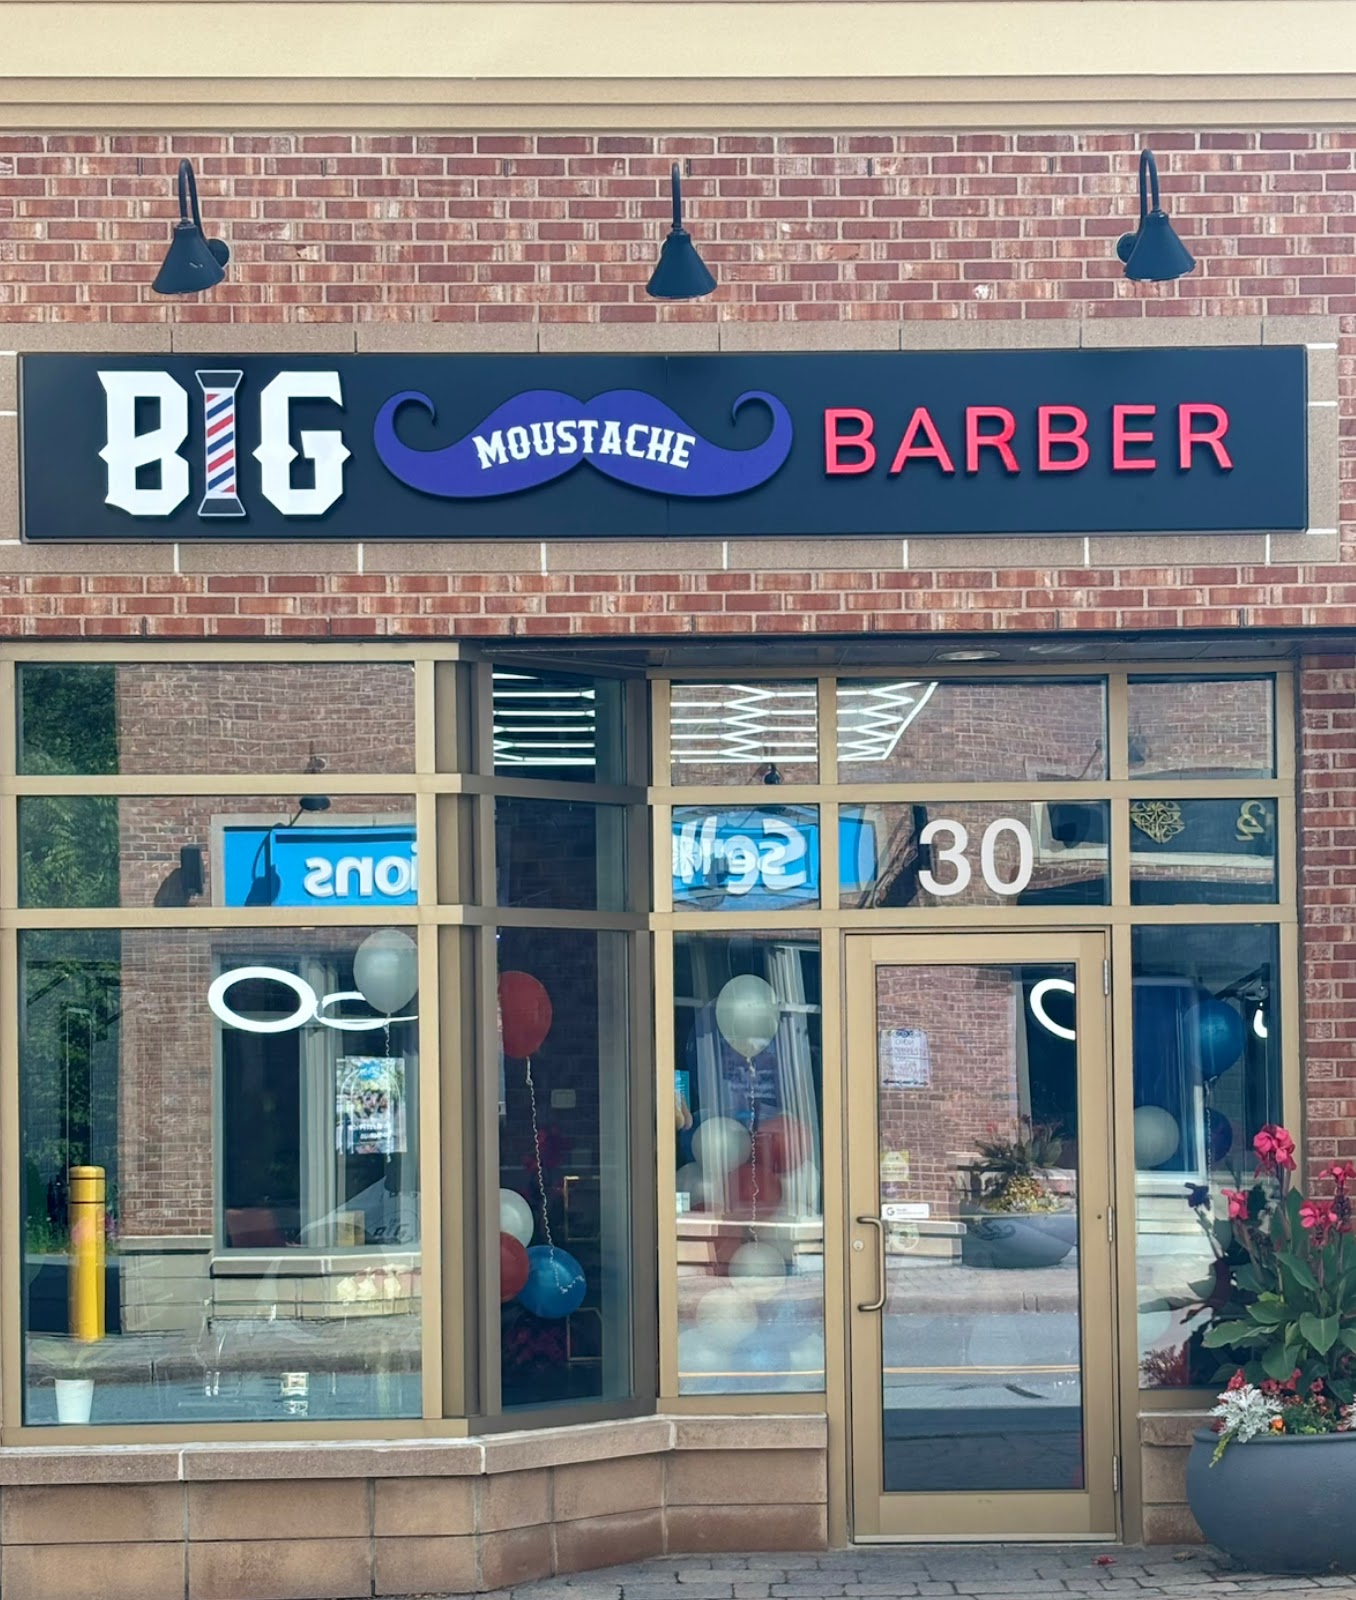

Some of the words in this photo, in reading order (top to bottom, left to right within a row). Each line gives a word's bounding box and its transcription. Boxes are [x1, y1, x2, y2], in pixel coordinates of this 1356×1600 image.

[97, 369, 352, 518] BIG
[472, 418, 697, 470] MOUSTACHE
[823, 402, 1235, 476] BARBER
[917, 817, 1034, 898] 30
